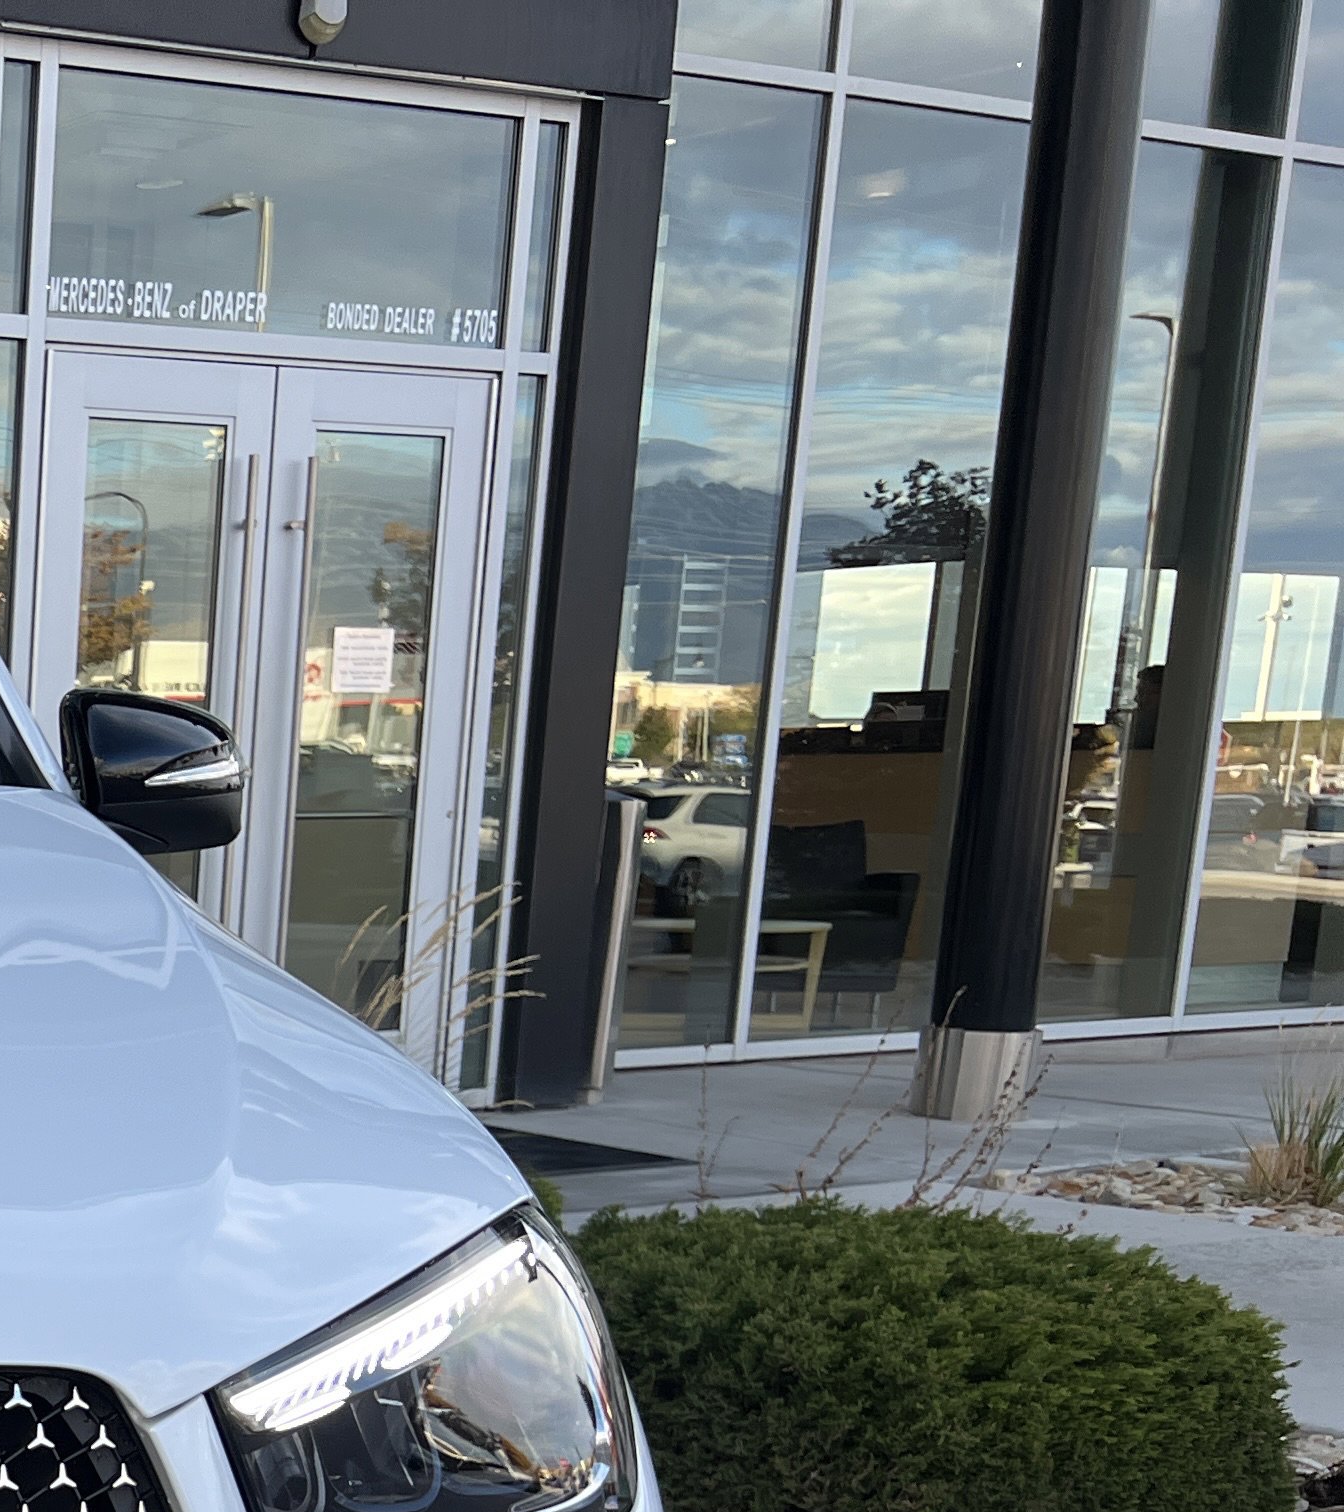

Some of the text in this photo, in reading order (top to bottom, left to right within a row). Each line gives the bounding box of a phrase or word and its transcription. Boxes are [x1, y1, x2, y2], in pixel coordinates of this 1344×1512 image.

[178, 299, 197, 320] of
[199, 289, 268, 323] DRAPER
[326, 302, 499, 344] BONDED DEALER #5705
